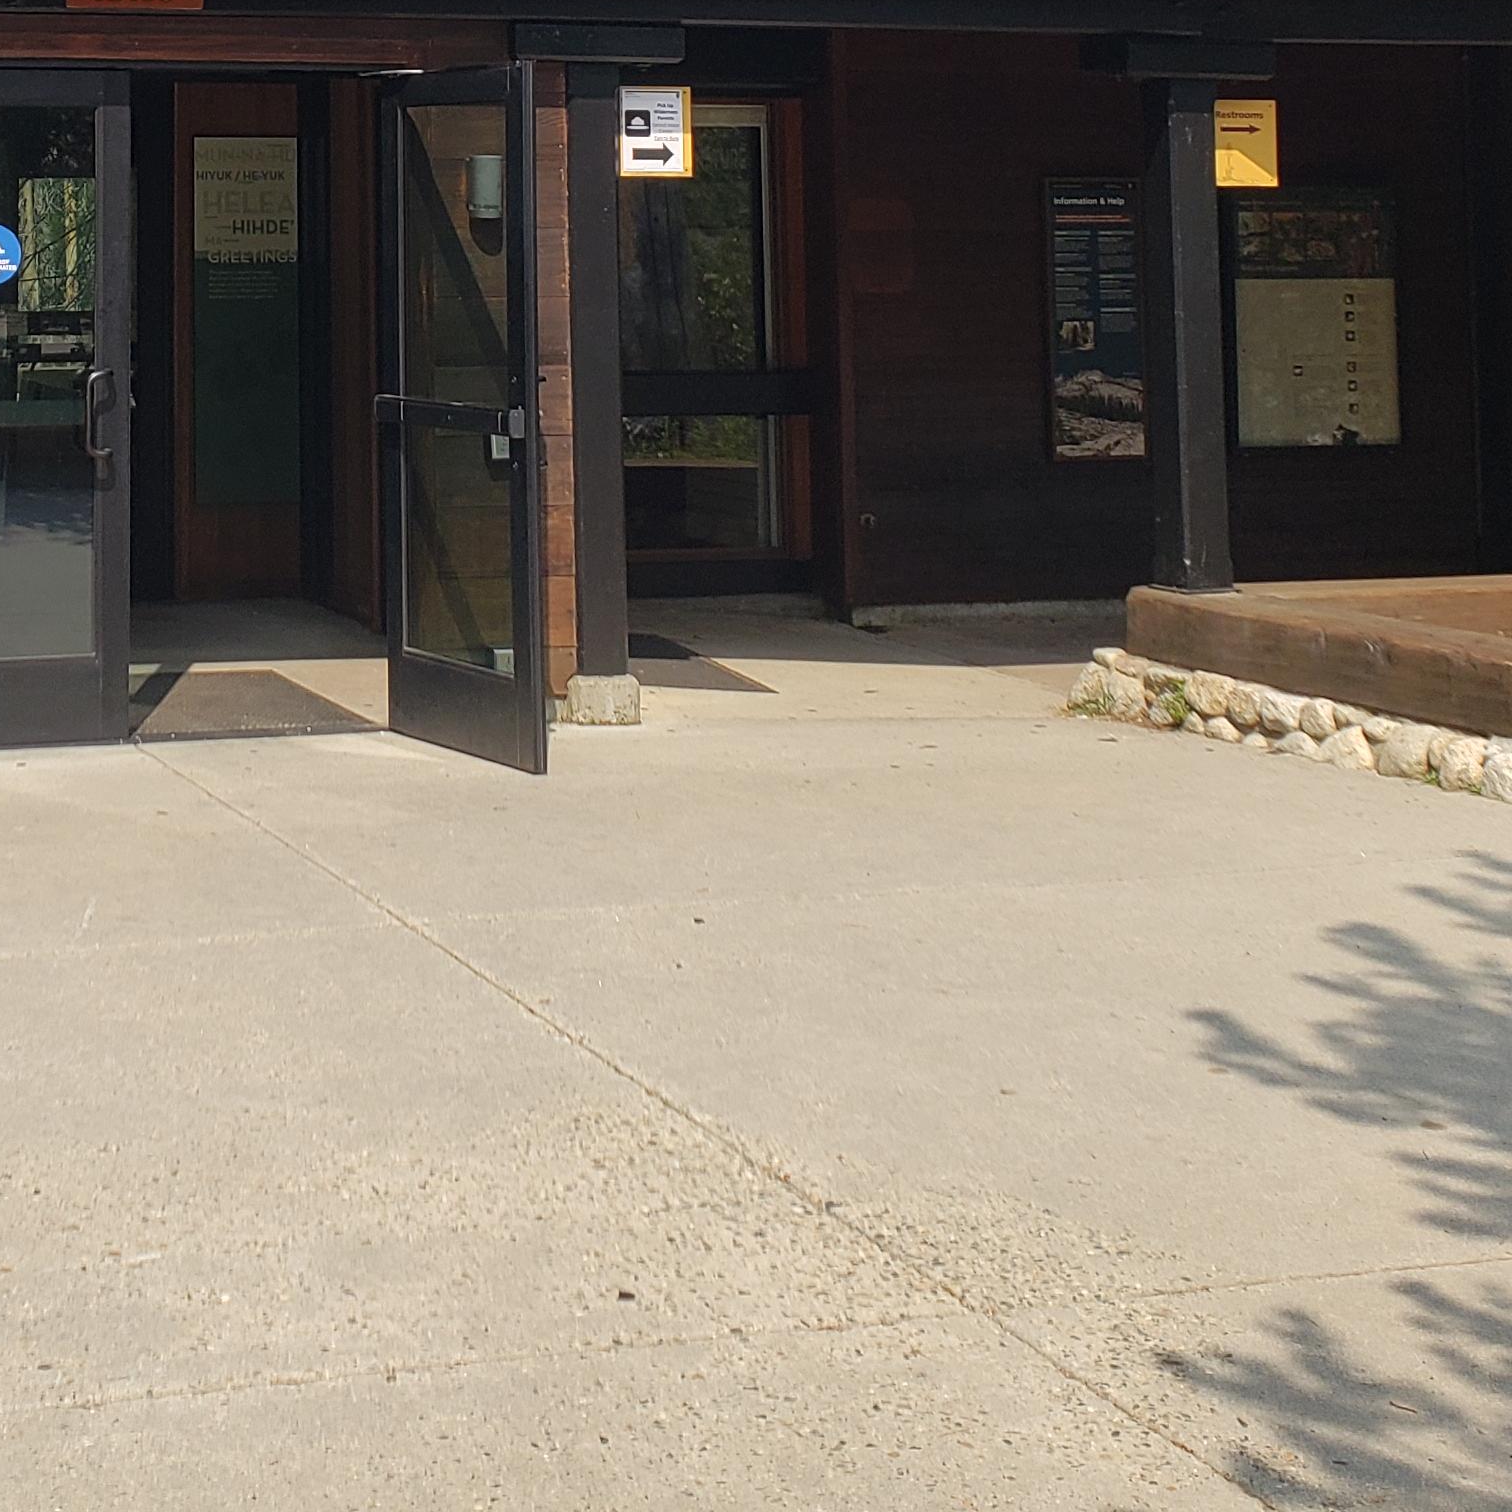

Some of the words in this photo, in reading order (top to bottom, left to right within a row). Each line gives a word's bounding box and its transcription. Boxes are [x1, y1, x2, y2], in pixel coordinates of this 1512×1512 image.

[1215, 110, 1264, 119] Restrooms
[196, 170, 232, 181] HIYUK
[1053, 197, 1098, 205] Information
[207, 249, 297, 264] GREETINGS
